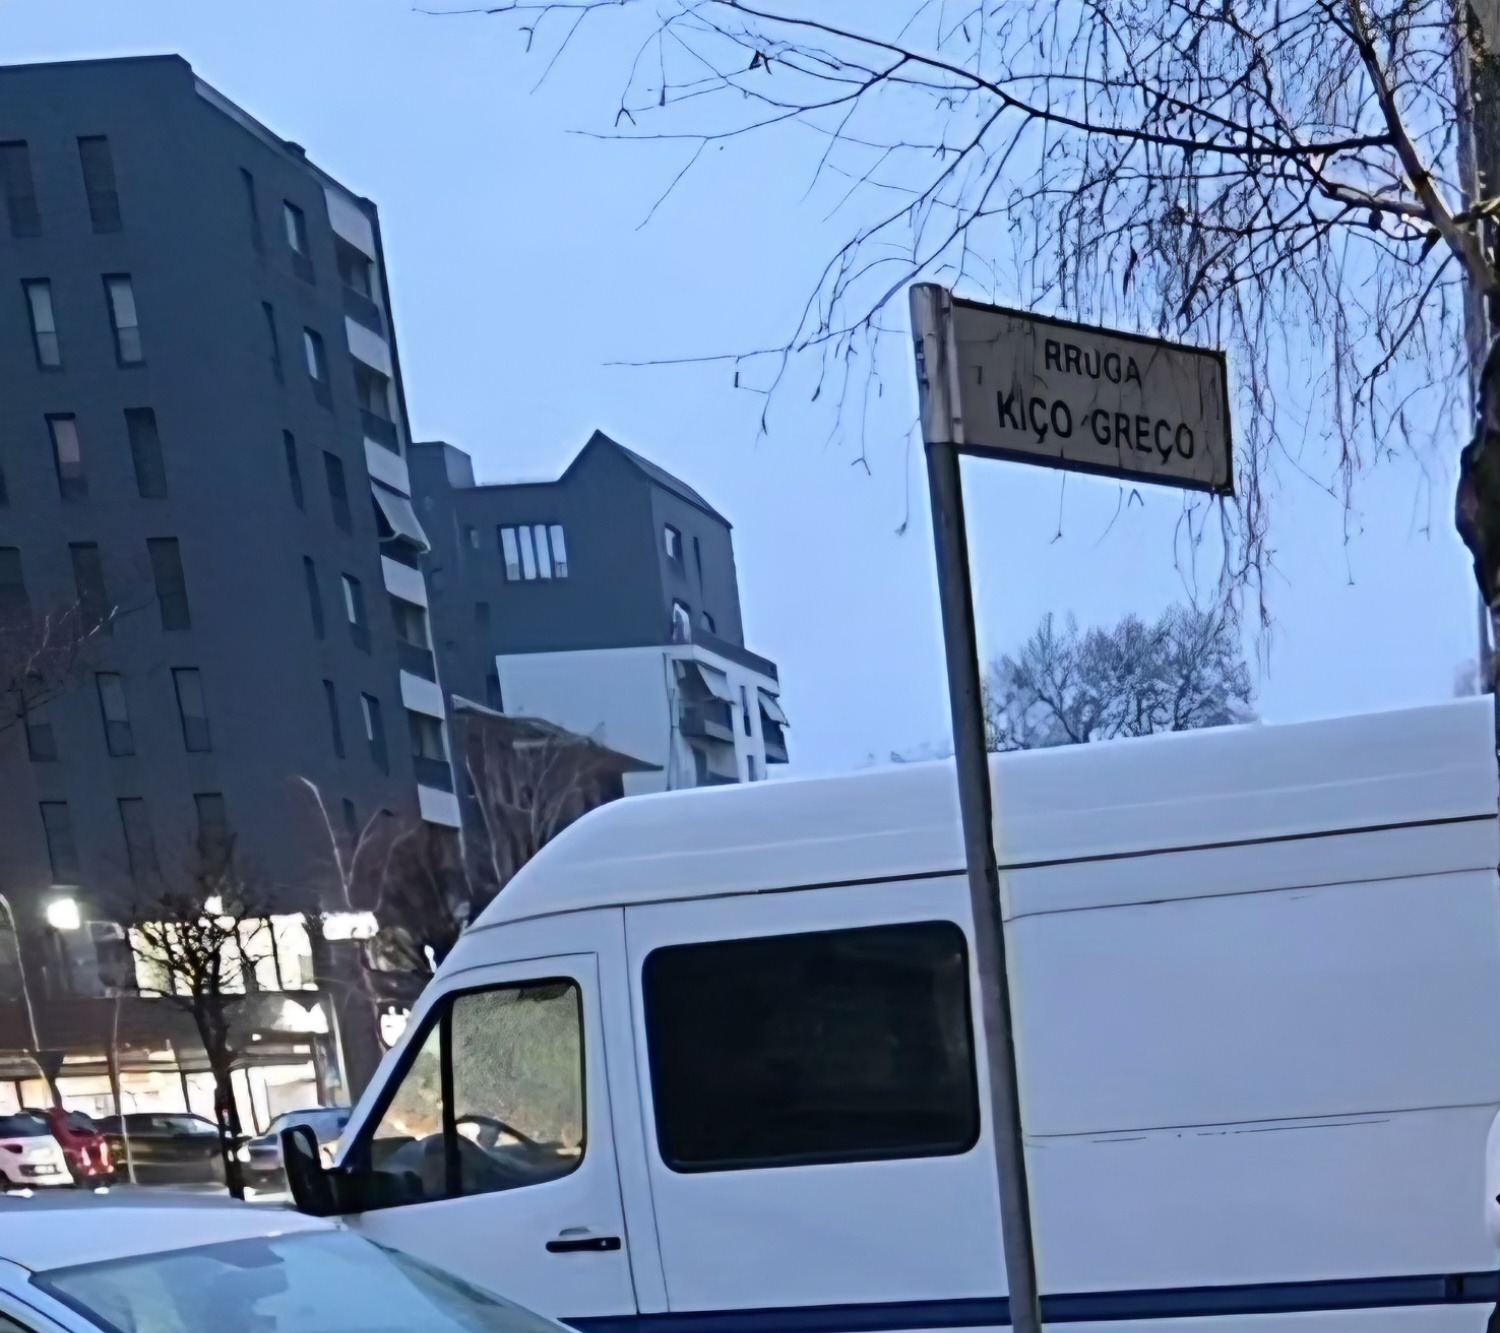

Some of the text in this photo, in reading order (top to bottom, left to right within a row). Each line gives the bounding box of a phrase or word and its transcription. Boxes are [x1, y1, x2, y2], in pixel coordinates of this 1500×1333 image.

[1044, 338, 1142, 389] RRUGA
[996, 390, 1194, 465] KIÇO GREÇO
